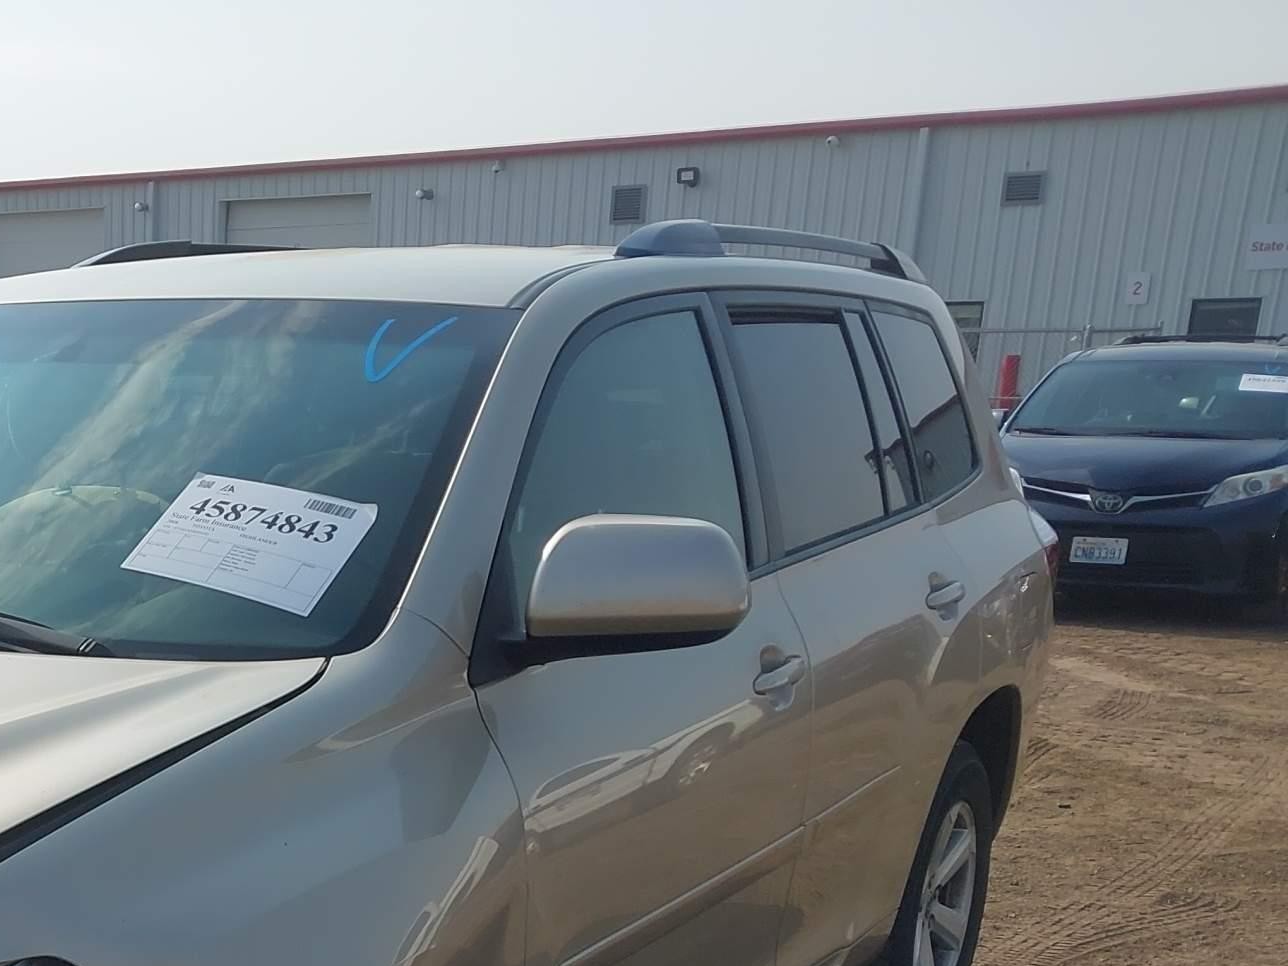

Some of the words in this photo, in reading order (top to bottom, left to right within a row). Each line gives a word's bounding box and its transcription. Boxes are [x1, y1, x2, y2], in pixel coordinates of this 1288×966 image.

[1251, 240, 1285, 252] State
[1132, 280, 1143, 296] 2
[172, 512, 188, 521] State
[190, 514, 210, 524] Farm
[211, 518, 248, 532] Insurance
[189, 497, 339, 544] 45874843
